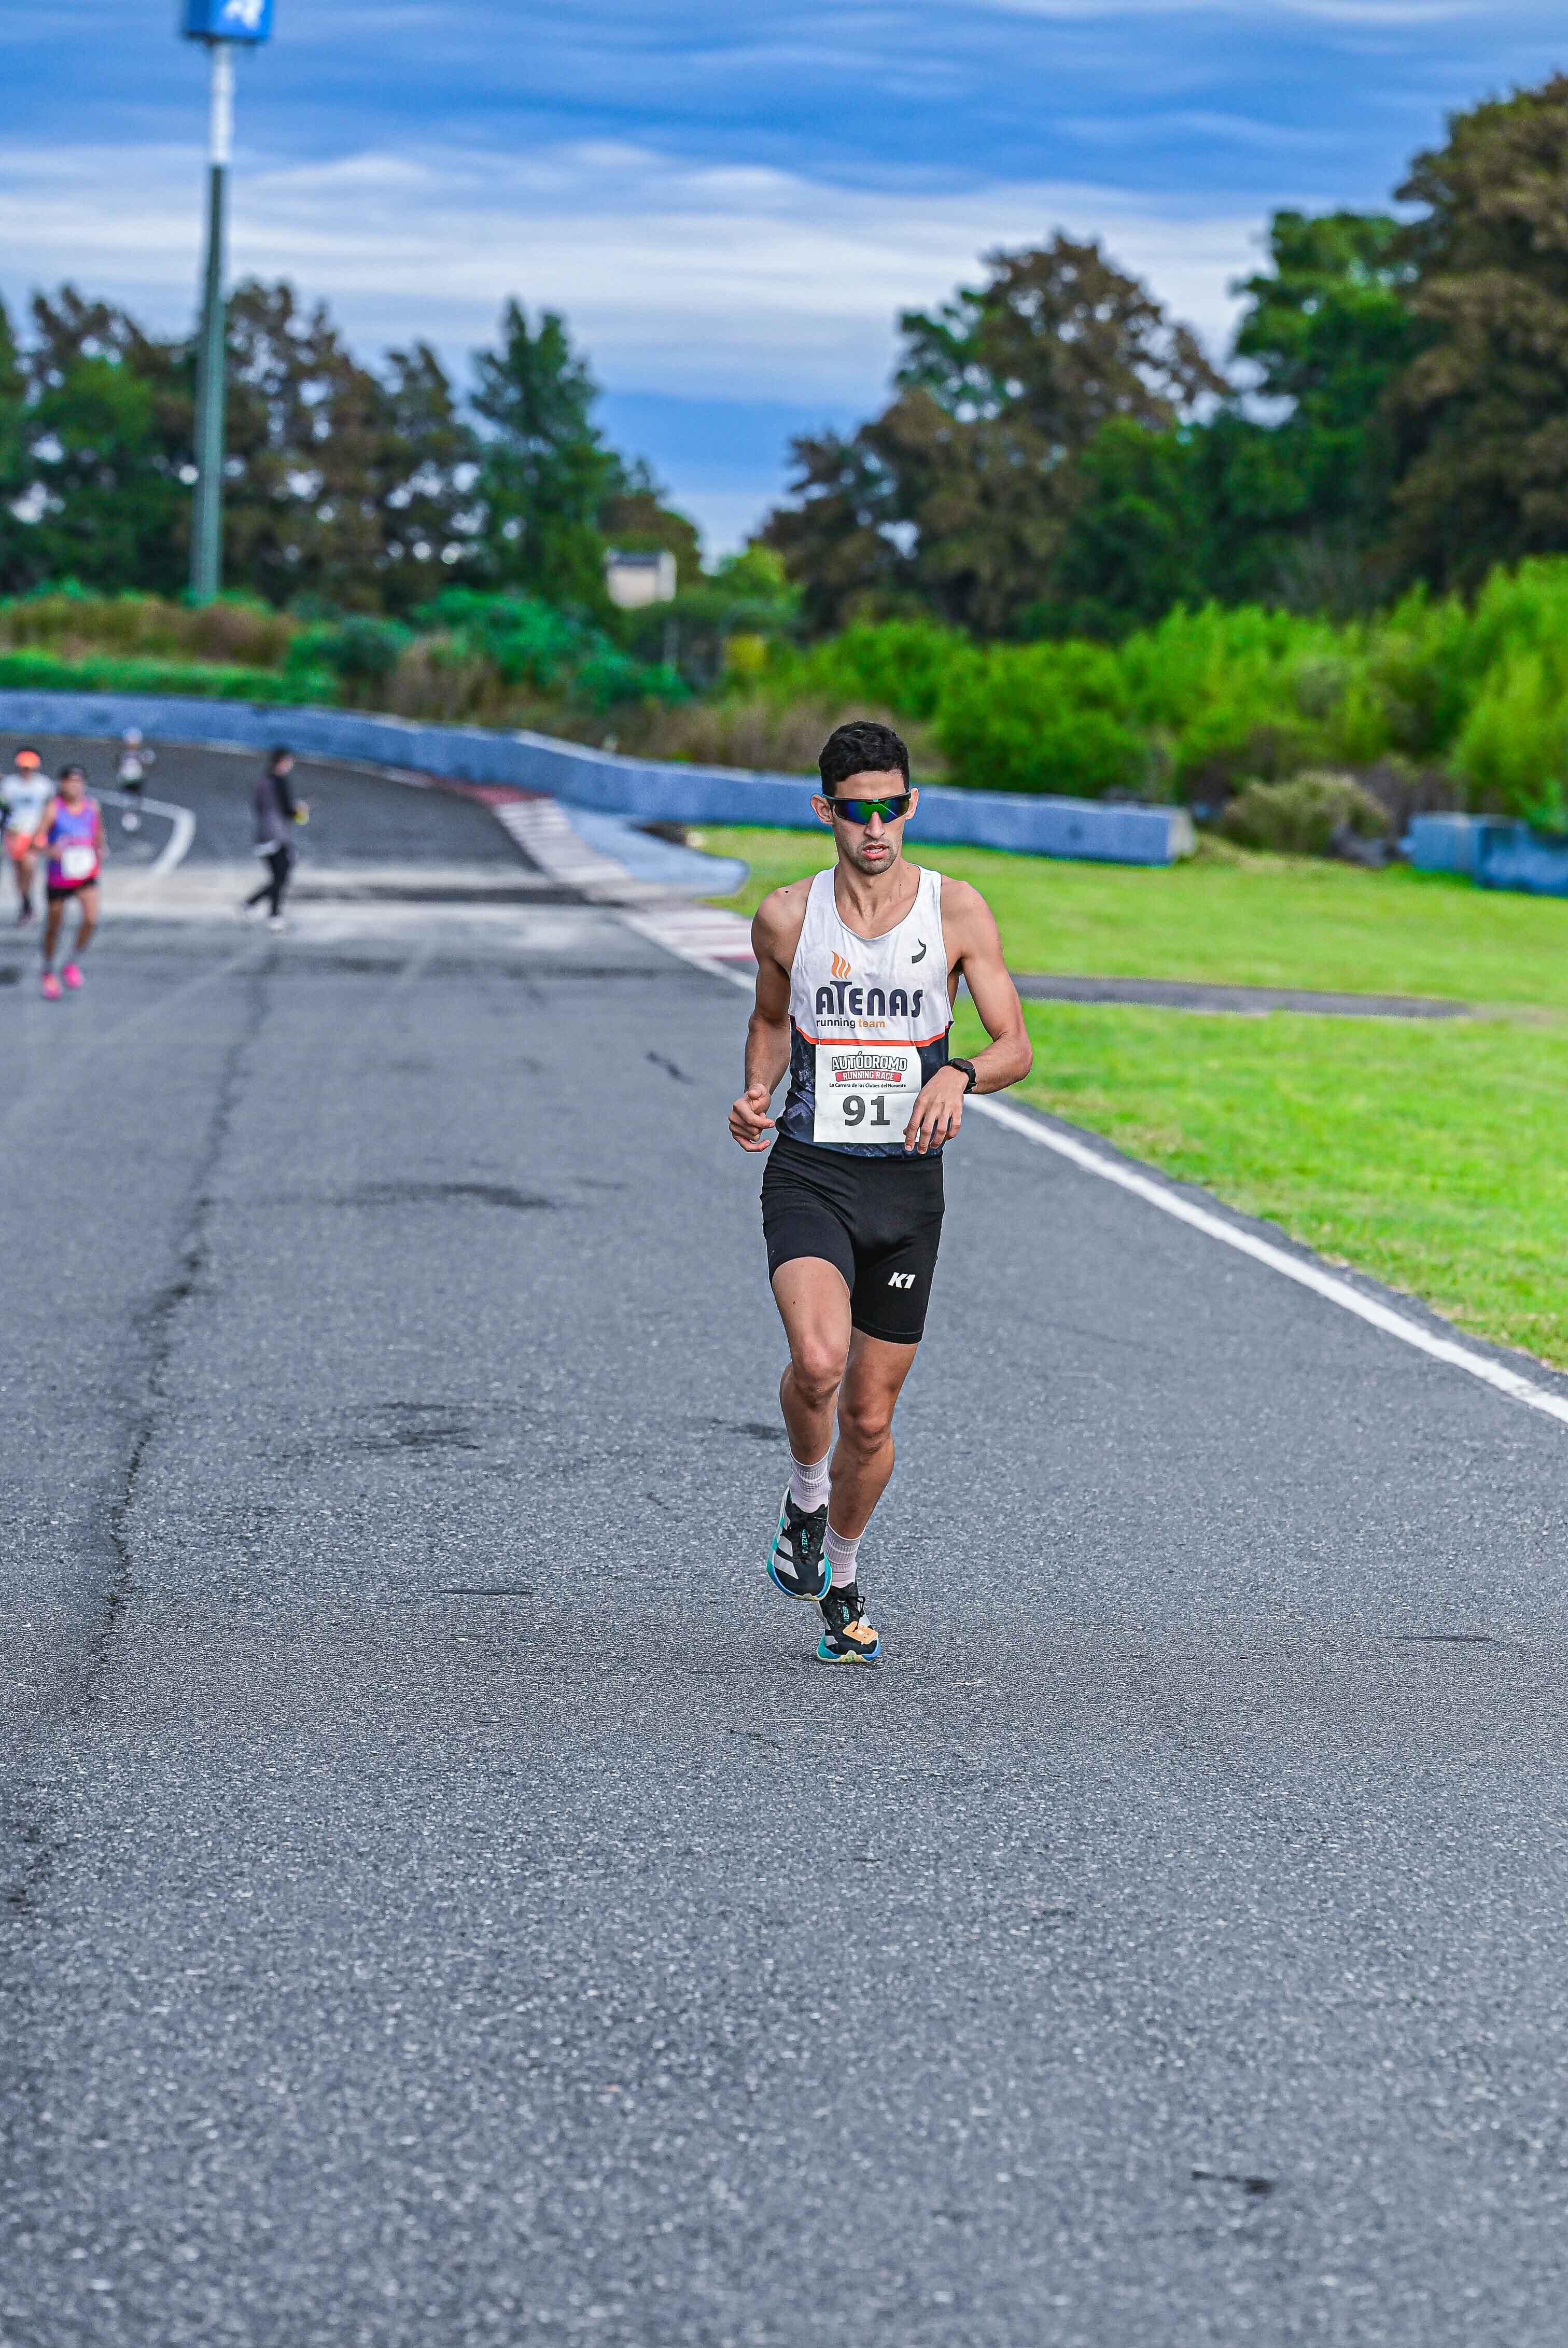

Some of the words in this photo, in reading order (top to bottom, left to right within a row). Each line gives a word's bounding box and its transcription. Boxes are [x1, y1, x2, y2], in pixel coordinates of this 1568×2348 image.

[816, 981, 923, 1018] ATENAS
[816, 1018, 855, 1029] running
[858, 1019, 886, 1028] team
[831, 1051, 907, 1071] AUTÓDROMO
[843, 1070, 874, 1080] RUNNING
[876, 1071, 894, 1080] RACE
[843, 1095, 890, 1127] 91
[887, 1272, 916, 1289] K1
